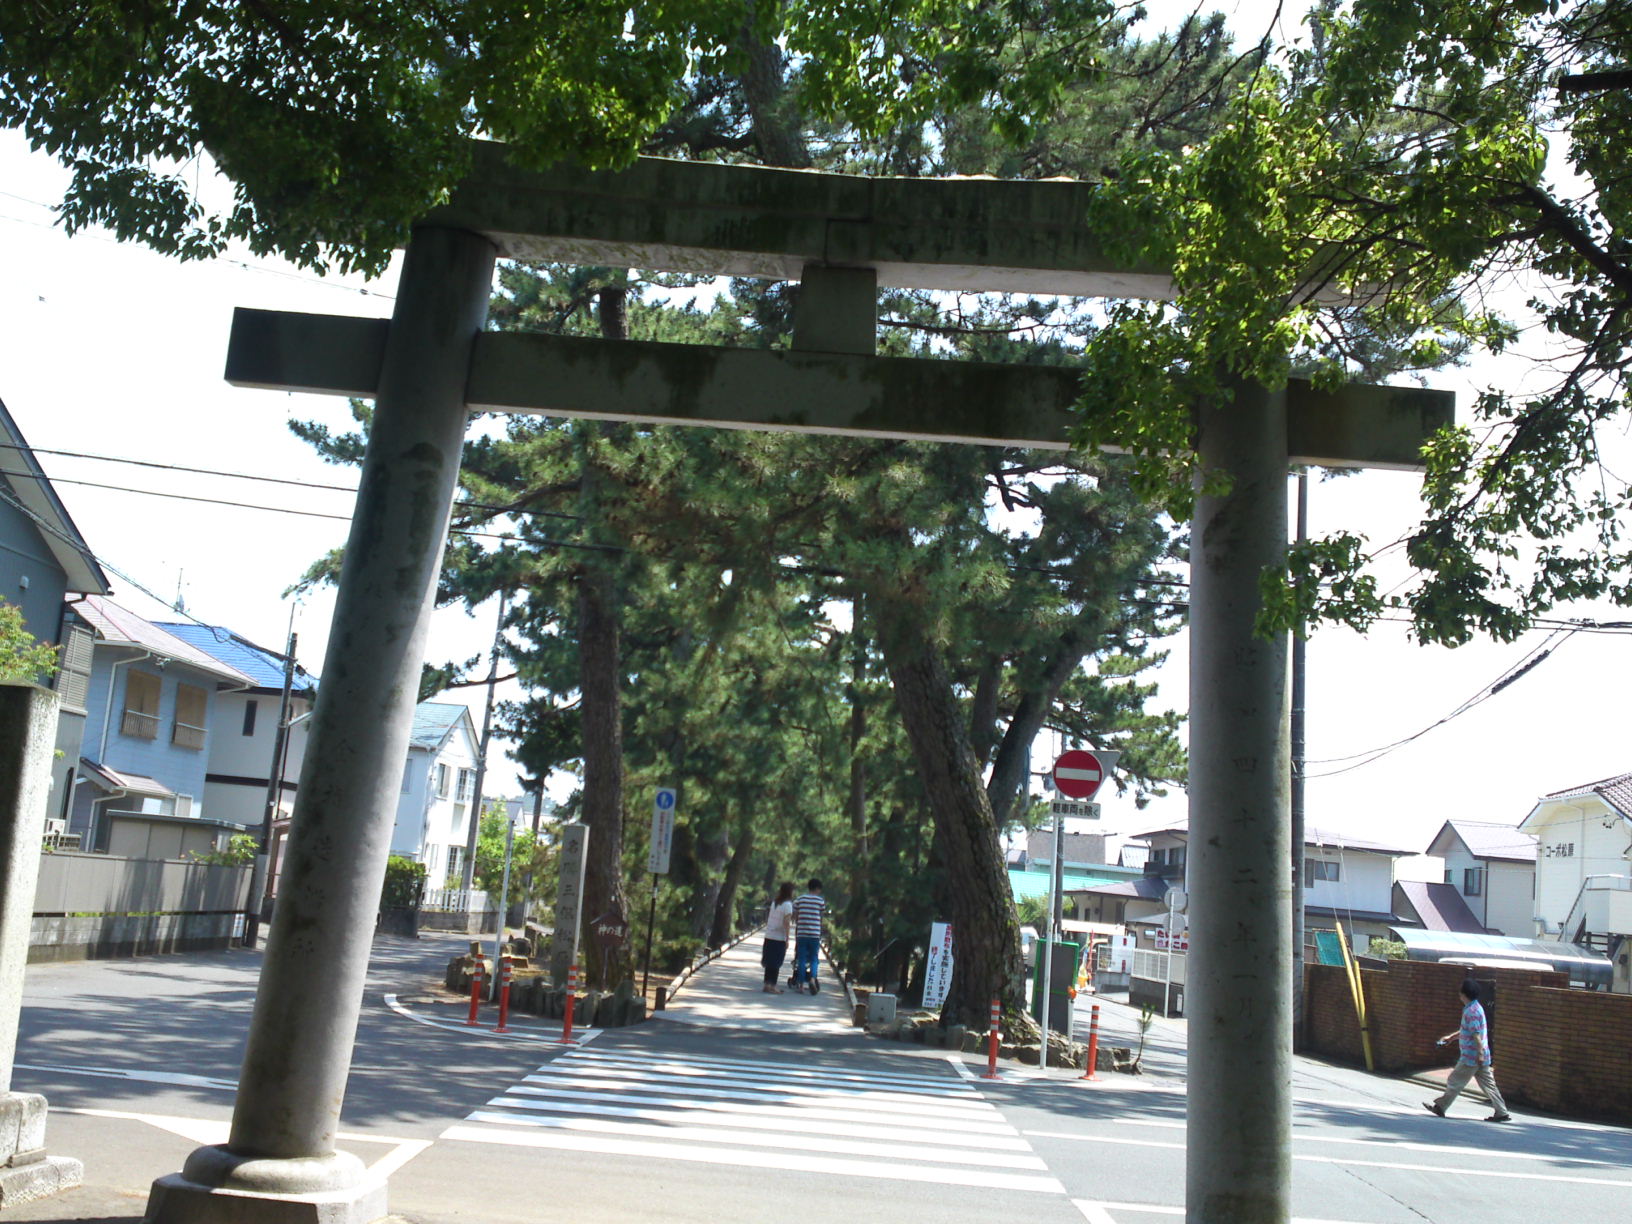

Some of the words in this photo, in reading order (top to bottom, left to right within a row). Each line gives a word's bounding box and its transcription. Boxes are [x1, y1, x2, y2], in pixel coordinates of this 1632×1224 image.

[1052, 802, 1099, 817] 軽車両を除く
[1546, 842, 1575, 858] コーポ松原
